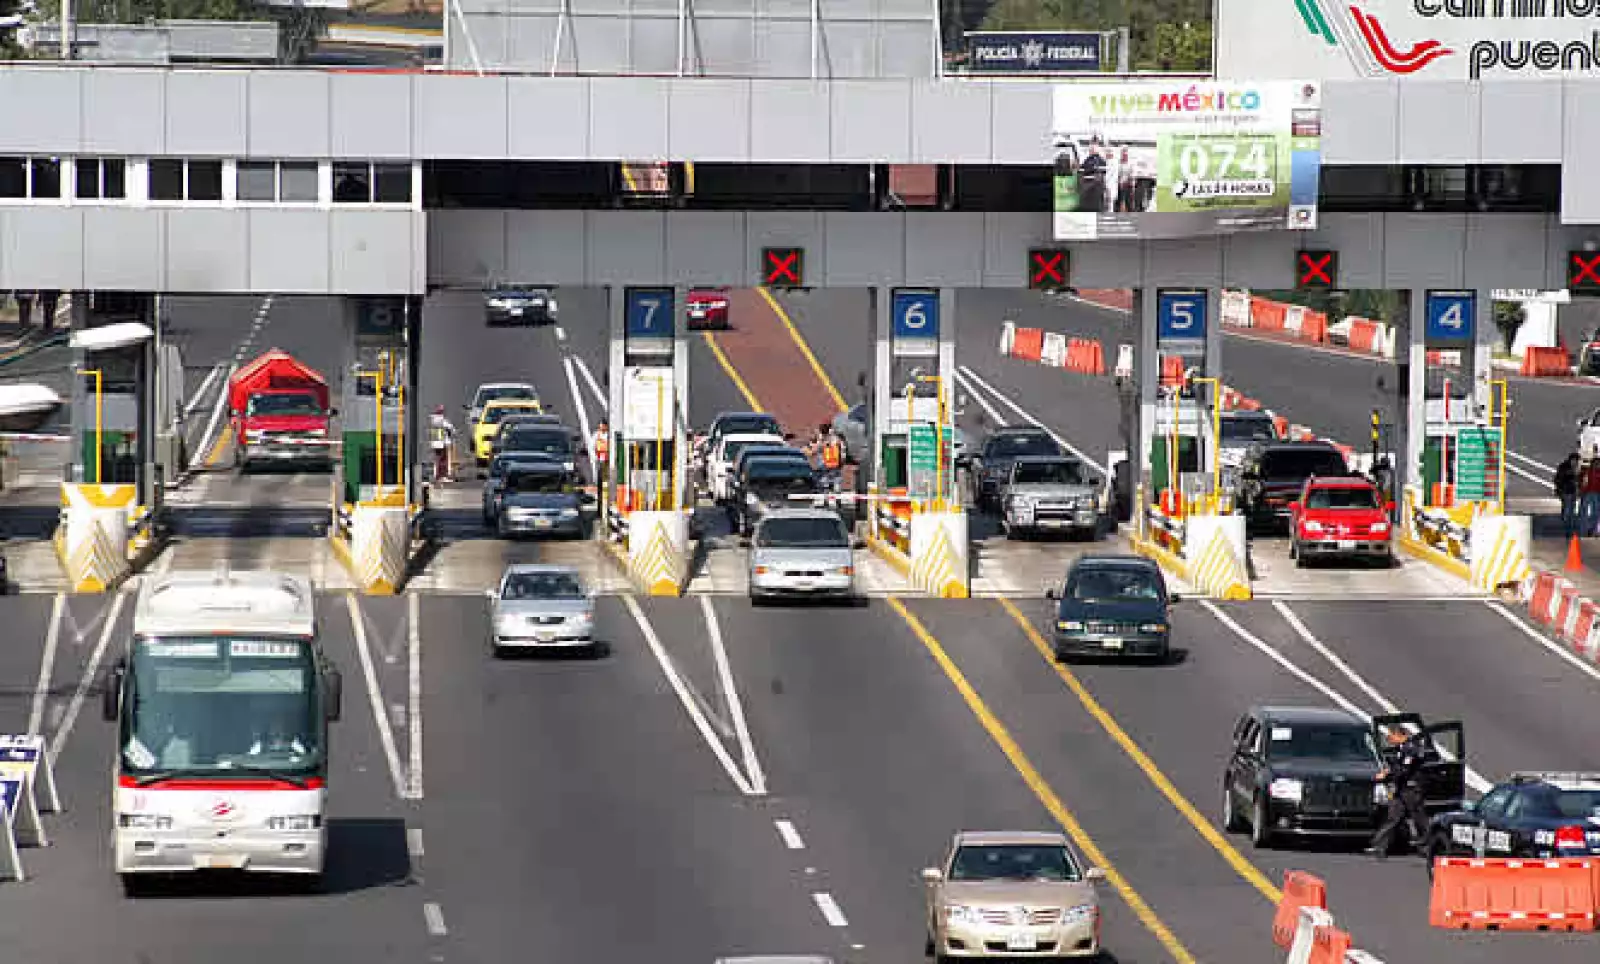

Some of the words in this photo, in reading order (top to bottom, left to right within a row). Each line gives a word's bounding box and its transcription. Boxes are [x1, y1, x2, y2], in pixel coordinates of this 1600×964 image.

[1047, 47, 1097, 59] FEDERAL
[1180, 144, 1268, 179] 074
[1192, 183, 1213, 195] LAS
[1214, 182, 1228, 194] 24
[1230, 181, 1272, 194] HORAS
[639, 299, 659, 329] 7
[905, 301, 926, 329] 6
[1170, 301, 1195, 330] 5
[1438, 302, 1464, 329] 4
